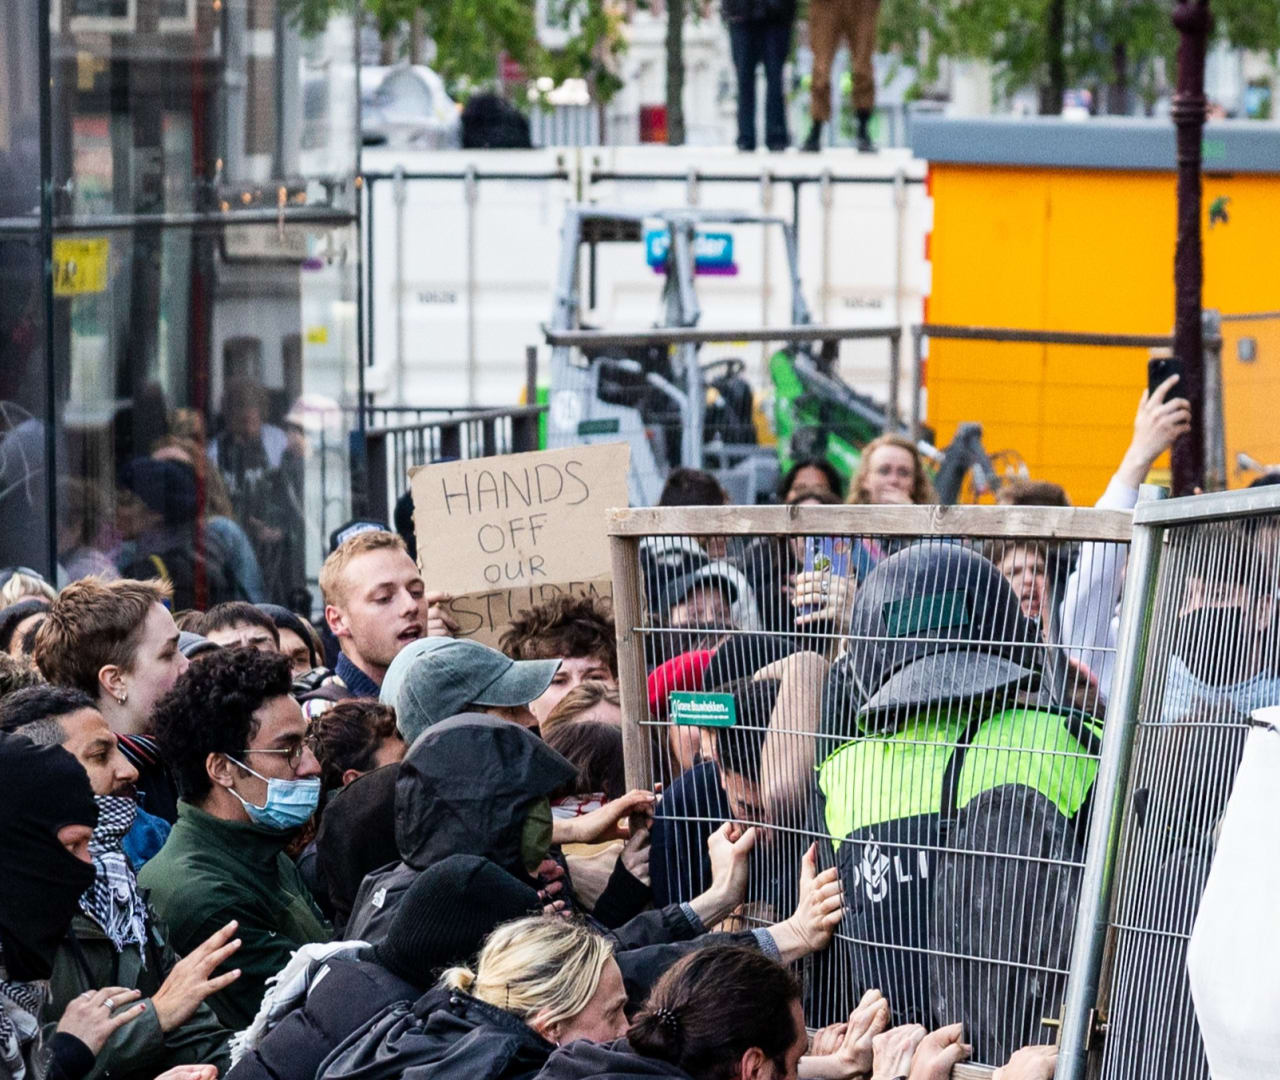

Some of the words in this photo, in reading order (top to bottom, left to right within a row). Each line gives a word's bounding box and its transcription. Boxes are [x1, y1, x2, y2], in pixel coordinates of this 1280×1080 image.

[442, 460, 589, 515] HANDS
[478, 513, 548, 554] OFF
[483, 554, 547, 584] OUR
